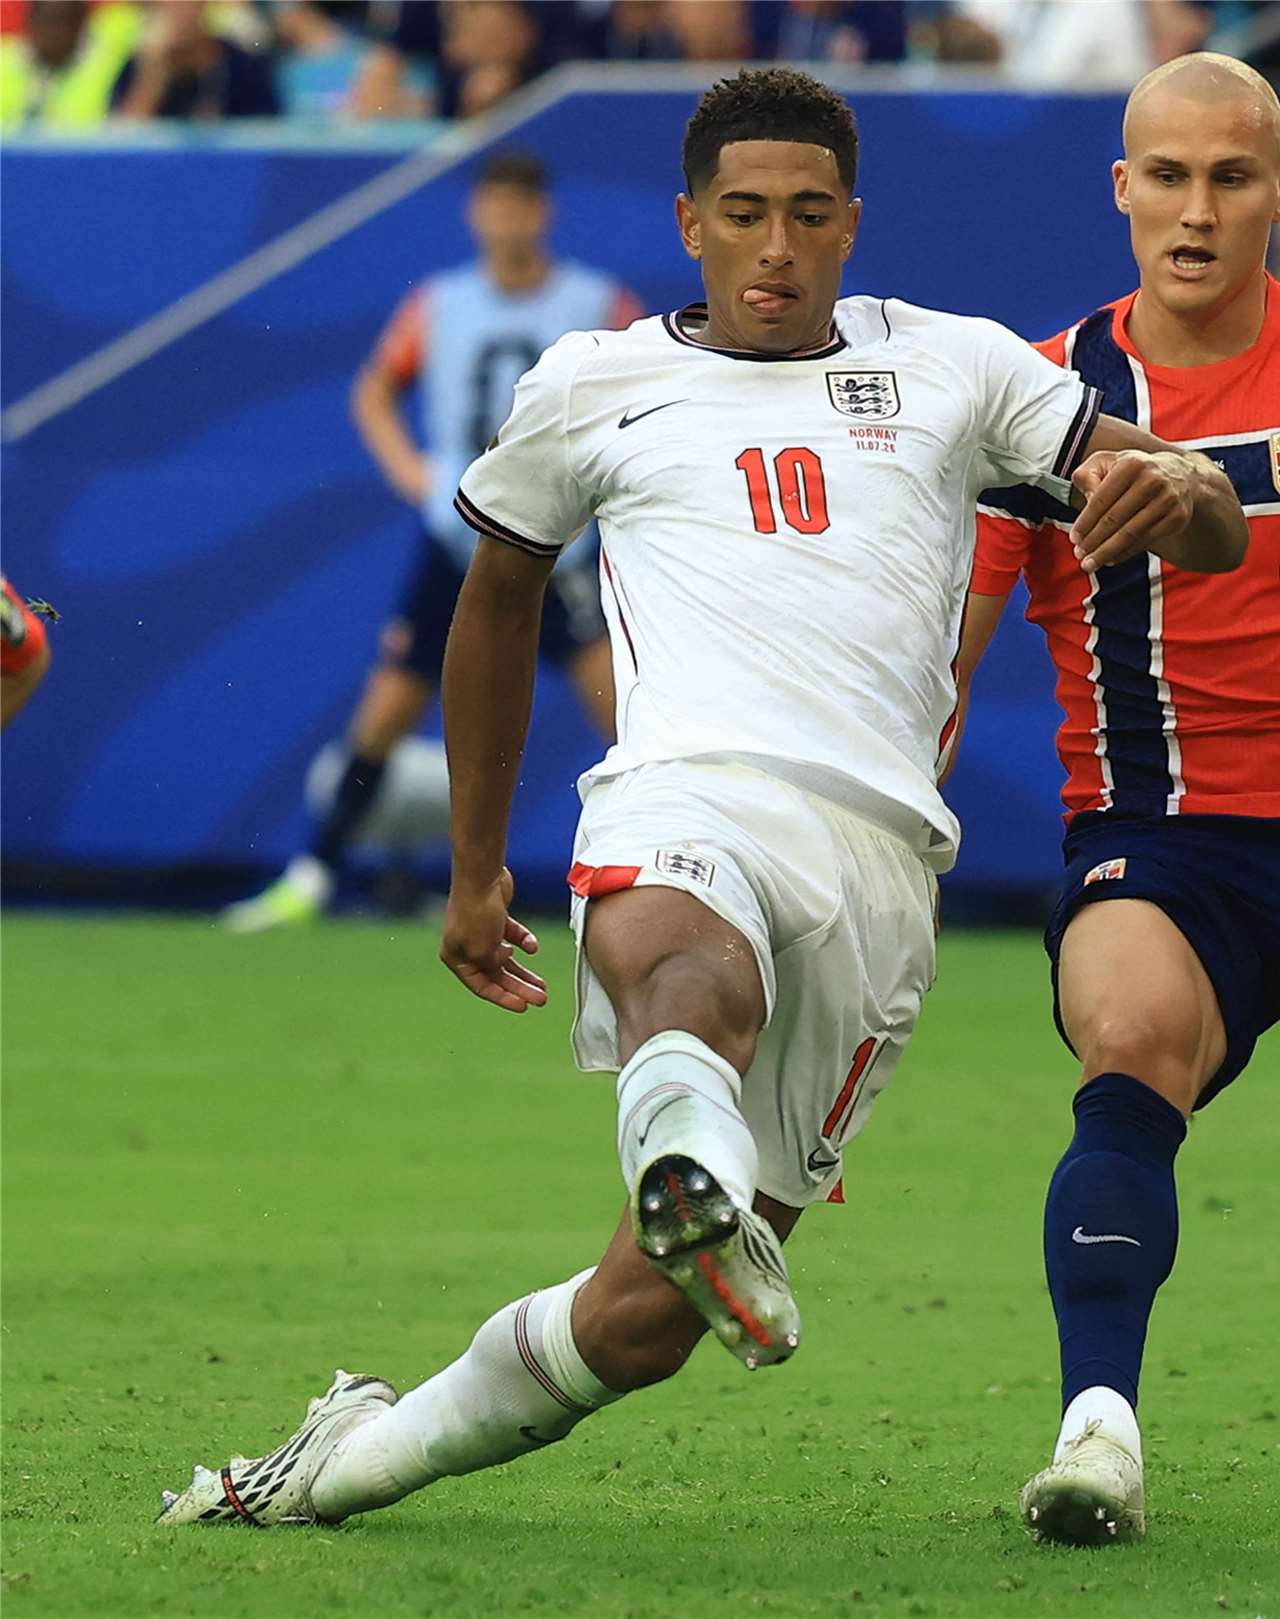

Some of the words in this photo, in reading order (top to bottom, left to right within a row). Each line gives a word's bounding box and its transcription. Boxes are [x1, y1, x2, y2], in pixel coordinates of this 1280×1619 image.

[849, 427, 897, 441] NORWAY
[735, 447, 830, 535] 10
[821, 1036, 889, 1143] 1
